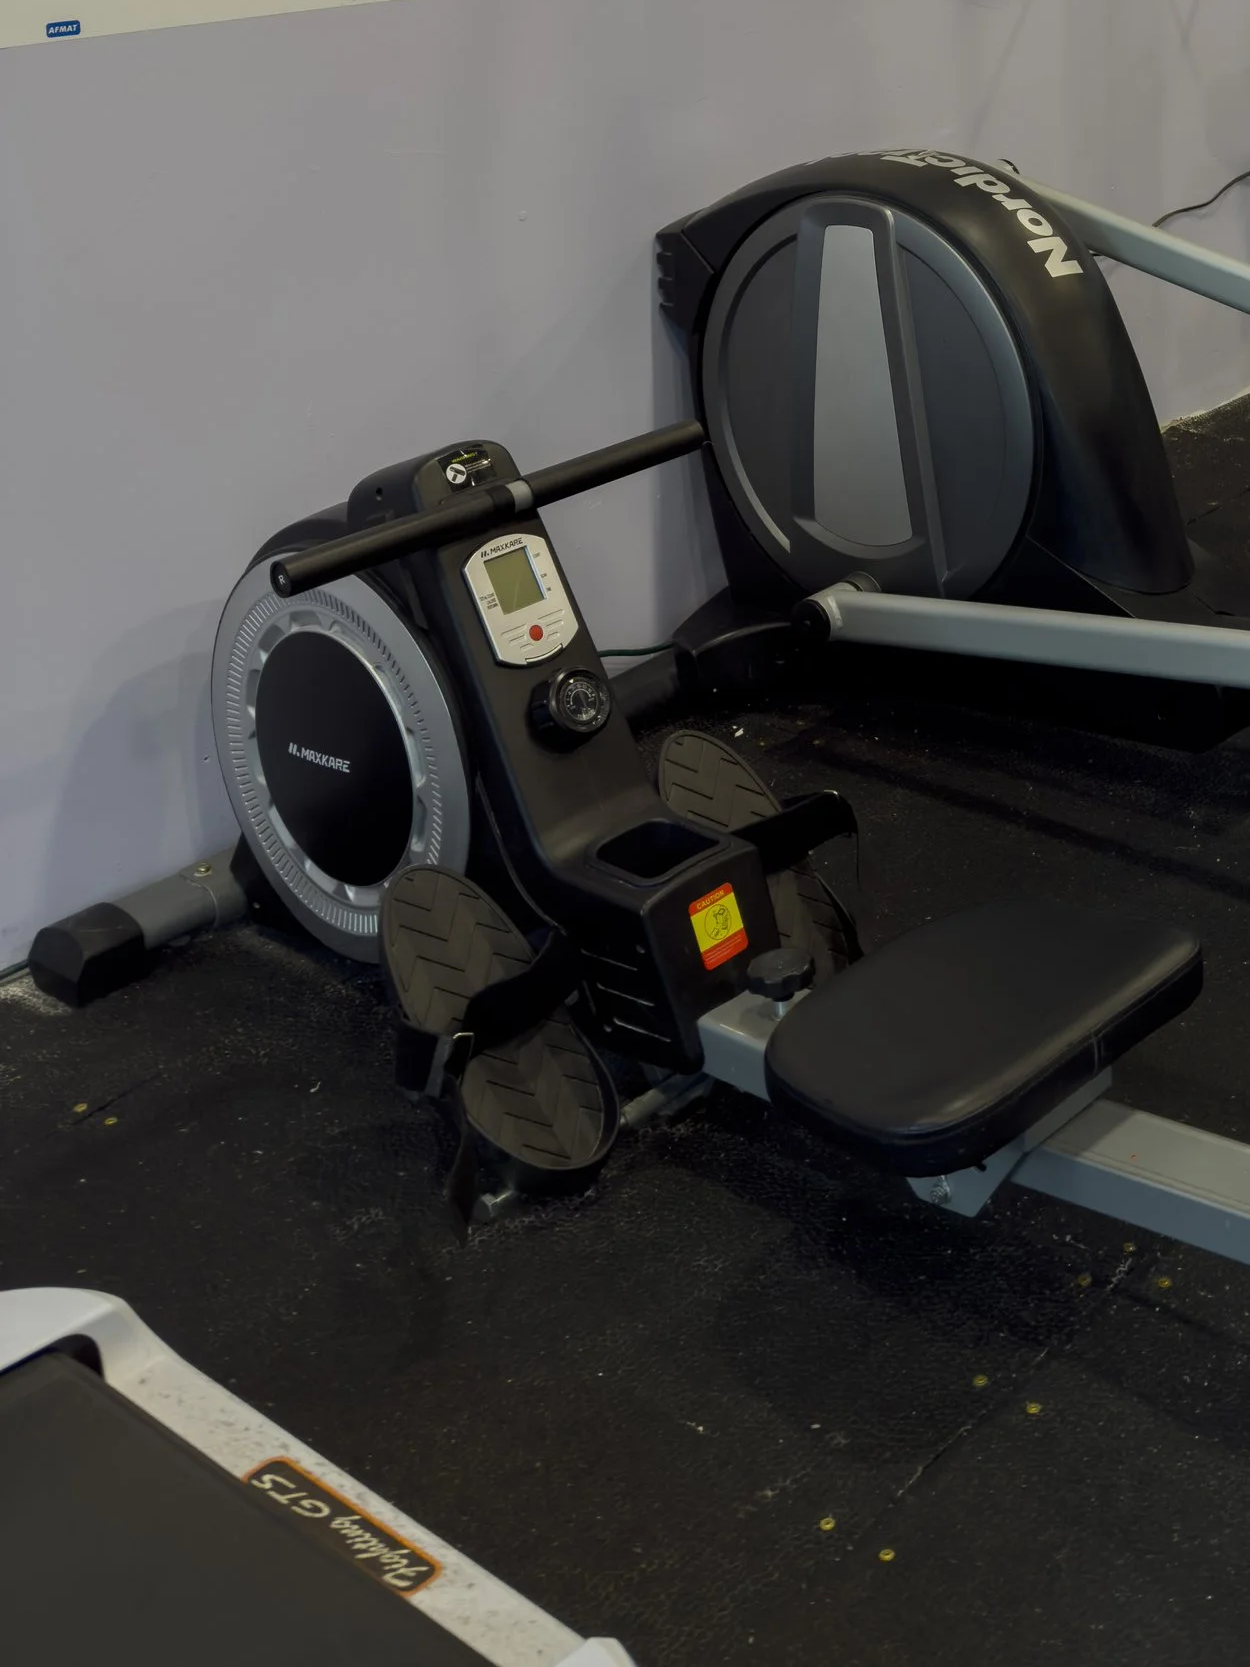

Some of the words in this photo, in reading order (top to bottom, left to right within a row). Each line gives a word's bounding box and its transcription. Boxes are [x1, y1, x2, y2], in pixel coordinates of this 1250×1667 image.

[48, 24, 78, 35] AFMAT
[490, 537, 524, 556] MAXKARE
[301, 746, 350, 773] MAXKARE
[696, 889, 724, 910] CAUTION
[250, 1473, 331, 1518] GTS
